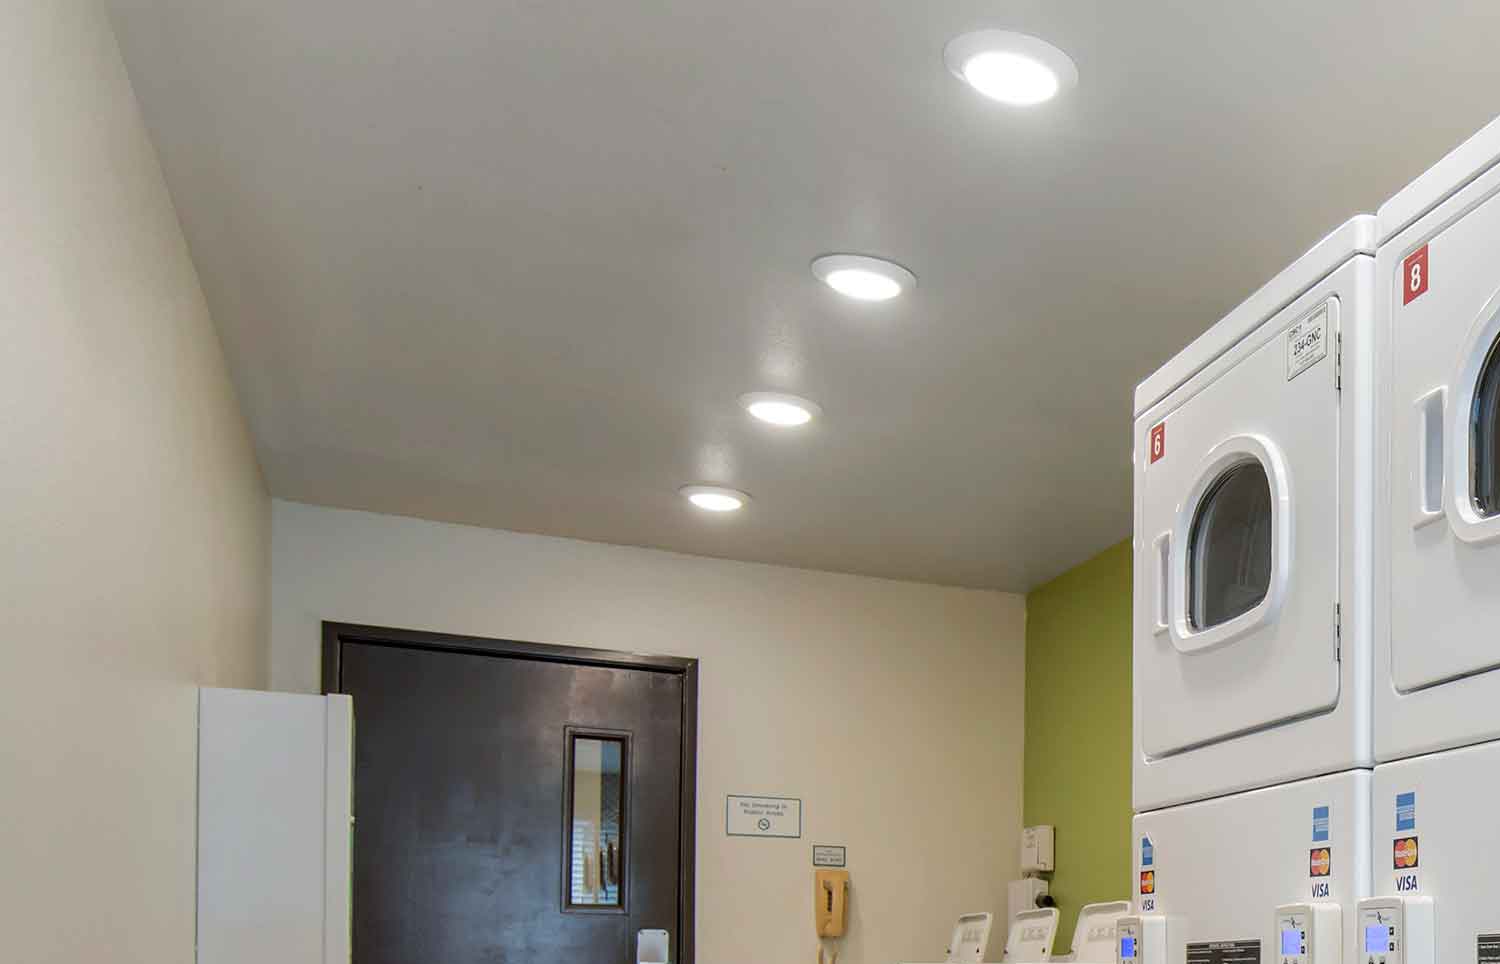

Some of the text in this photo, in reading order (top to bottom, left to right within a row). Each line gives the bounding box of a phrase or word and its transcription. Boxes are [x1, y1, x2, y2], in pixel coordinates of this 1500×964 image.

[1411, 263, 1421, 292] 8
[1154, 433, 1161, 450] 6
[1311, 882, 1330, 898] VISA
[1395, 875, 1418, 891] VISA
